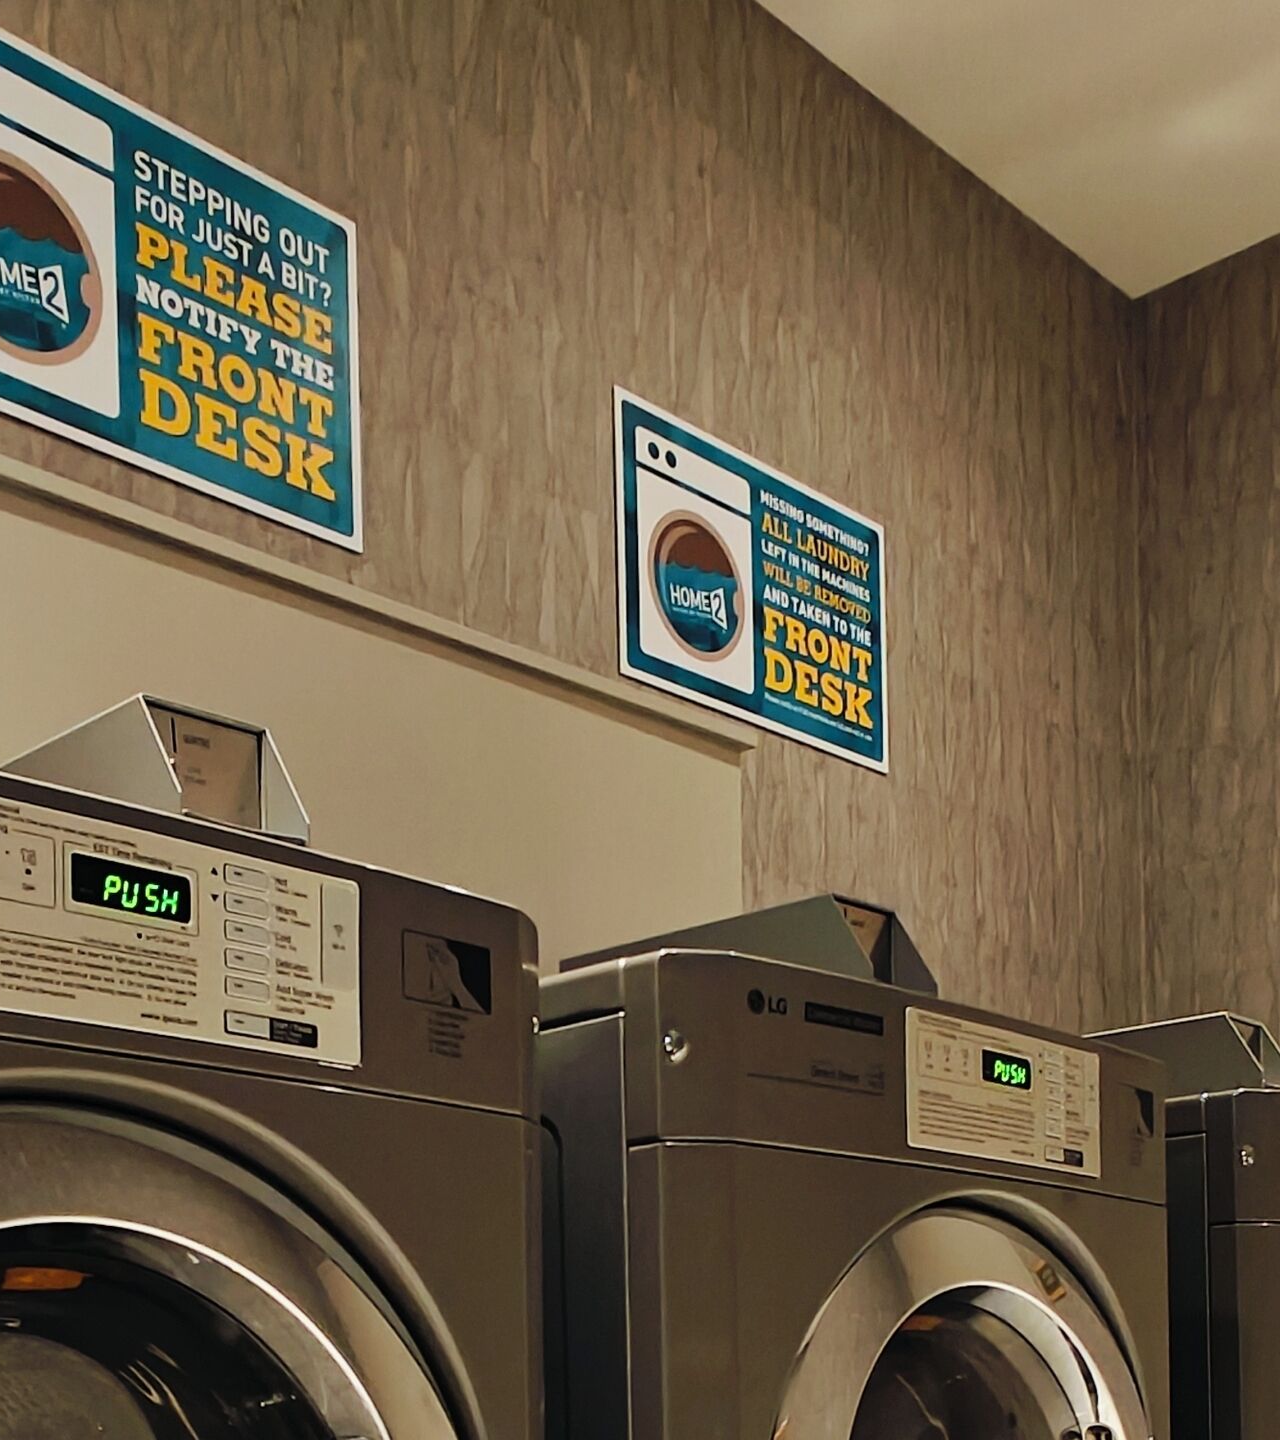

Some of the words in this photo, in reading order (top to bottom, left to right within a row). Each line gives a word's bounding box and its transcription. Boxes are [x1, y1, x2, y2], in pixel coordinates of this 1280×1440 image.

[134, 150, 270, 244] STEPPING
[279, 228, 330, 273] OUT
[135, 185, 185, 235] FOR
[192, 218, 253, 267] JUST
[258, 251, 275, 281] A
[281, 261, 332, 307] BIT?
[135, 221, 333, 355] PLEASE
[135, 274, 262, 355] NOTIFY
[271, 339, 334, 391] THE
[138, 312, 333, 439] FRONT
[139, 368, 336, 501] DESK
[760, 489, 804, 523] MISSING
[761, 538, 786, 562] LEFT
[788, 551, 800, 568] IN
[801, 557, 820, 579] THE
[822, 568, 870, 602] MACHINES
[762, 512, 792, 544] ALL
[797, 528, 869, 581] LAUNDRY
[763, 561, 793, 588] WILL
[796, 575, 811, 596] BE
[815, 584, 871, 624] REMOVED
[763, 584, 789, 608] AND
[791, 596, 831, 628] TAKEN
[832, 615, 847, 635] TO
[849, 623, 872, 647] THE
[764, 606, 872, 682] FRONT
[764, 646, 873, 729] DESK
[103, 875, 179, 915] PUSH
[768, 997, 788, 1015] LG
[994, 1060, 1026, 1084] PUSH
